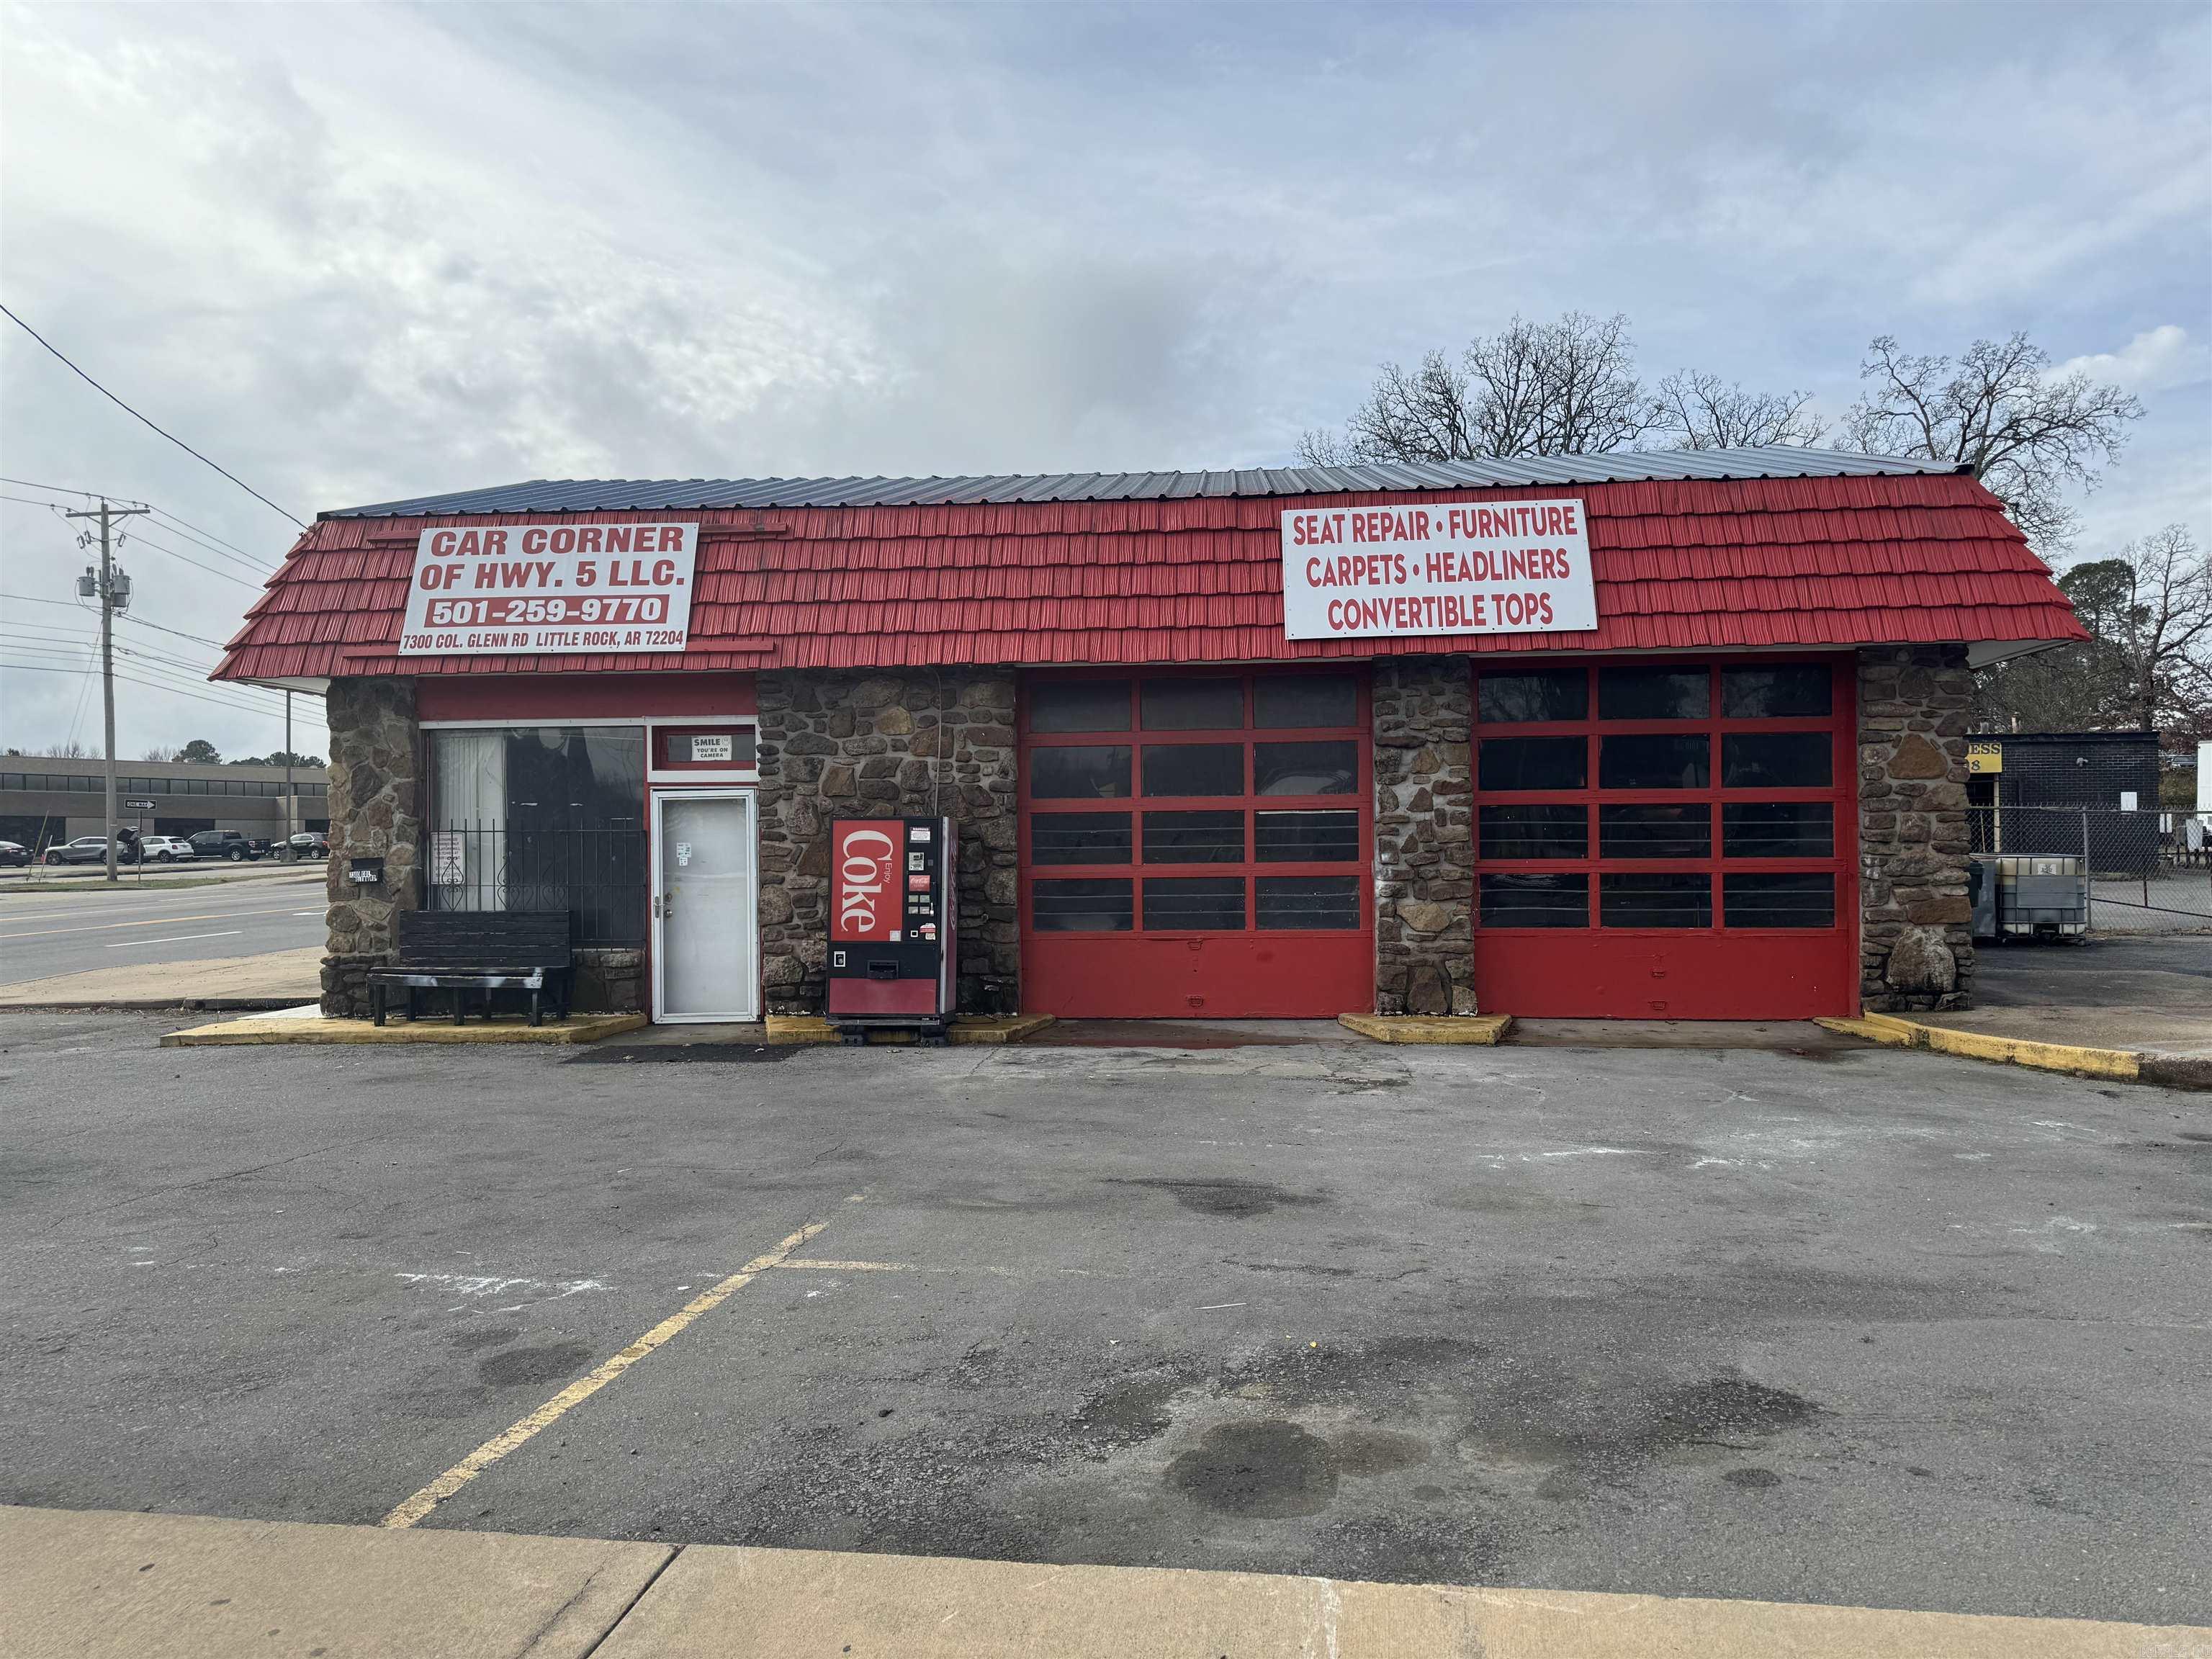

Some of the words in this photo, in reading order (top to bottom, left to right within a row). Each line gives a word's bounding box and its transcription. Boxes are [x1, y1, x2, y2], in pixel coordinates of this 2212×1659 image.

[1293, 514, 1345, 545] SEAT
[1352, 511, 1430, 543] REPAIR
[1448, 505, 1578, 539] FURNITURE
[431, 530, 506, 557] CAR
[521, 526, 683, 555] CORNER
[419, 563, 465, 590] OF
[474, 561, 563, 590] HWY.
[575, 560, 597, 588] 5
[608, 559, 685, 587] LLC.
[1306, 553, 1407, 588] CARPETS
[1426, 547, 1570, 583] HEADLINERS
[432, 598, 662, 625] 501-259-9770
[1328, 594, 1486, 631] CONVERTIBLE
[1491, 592, 1553, 626] TOPS
[403, 634, 432, 649] 7300
[436, 633, 463, 648] COL.
[467, 632, 508, 648] GLENN
[511, 631, 529, 647] RD
[536, 631, 579, 647] LITTLE
[583, 631, 621, 648] ROCK,
[624, 631, 641, 645] AR
[645, 630, 684, 645] 72204
[841, 830, 894, 932] Coke
[883, 863, 892, 884] Enjoy
